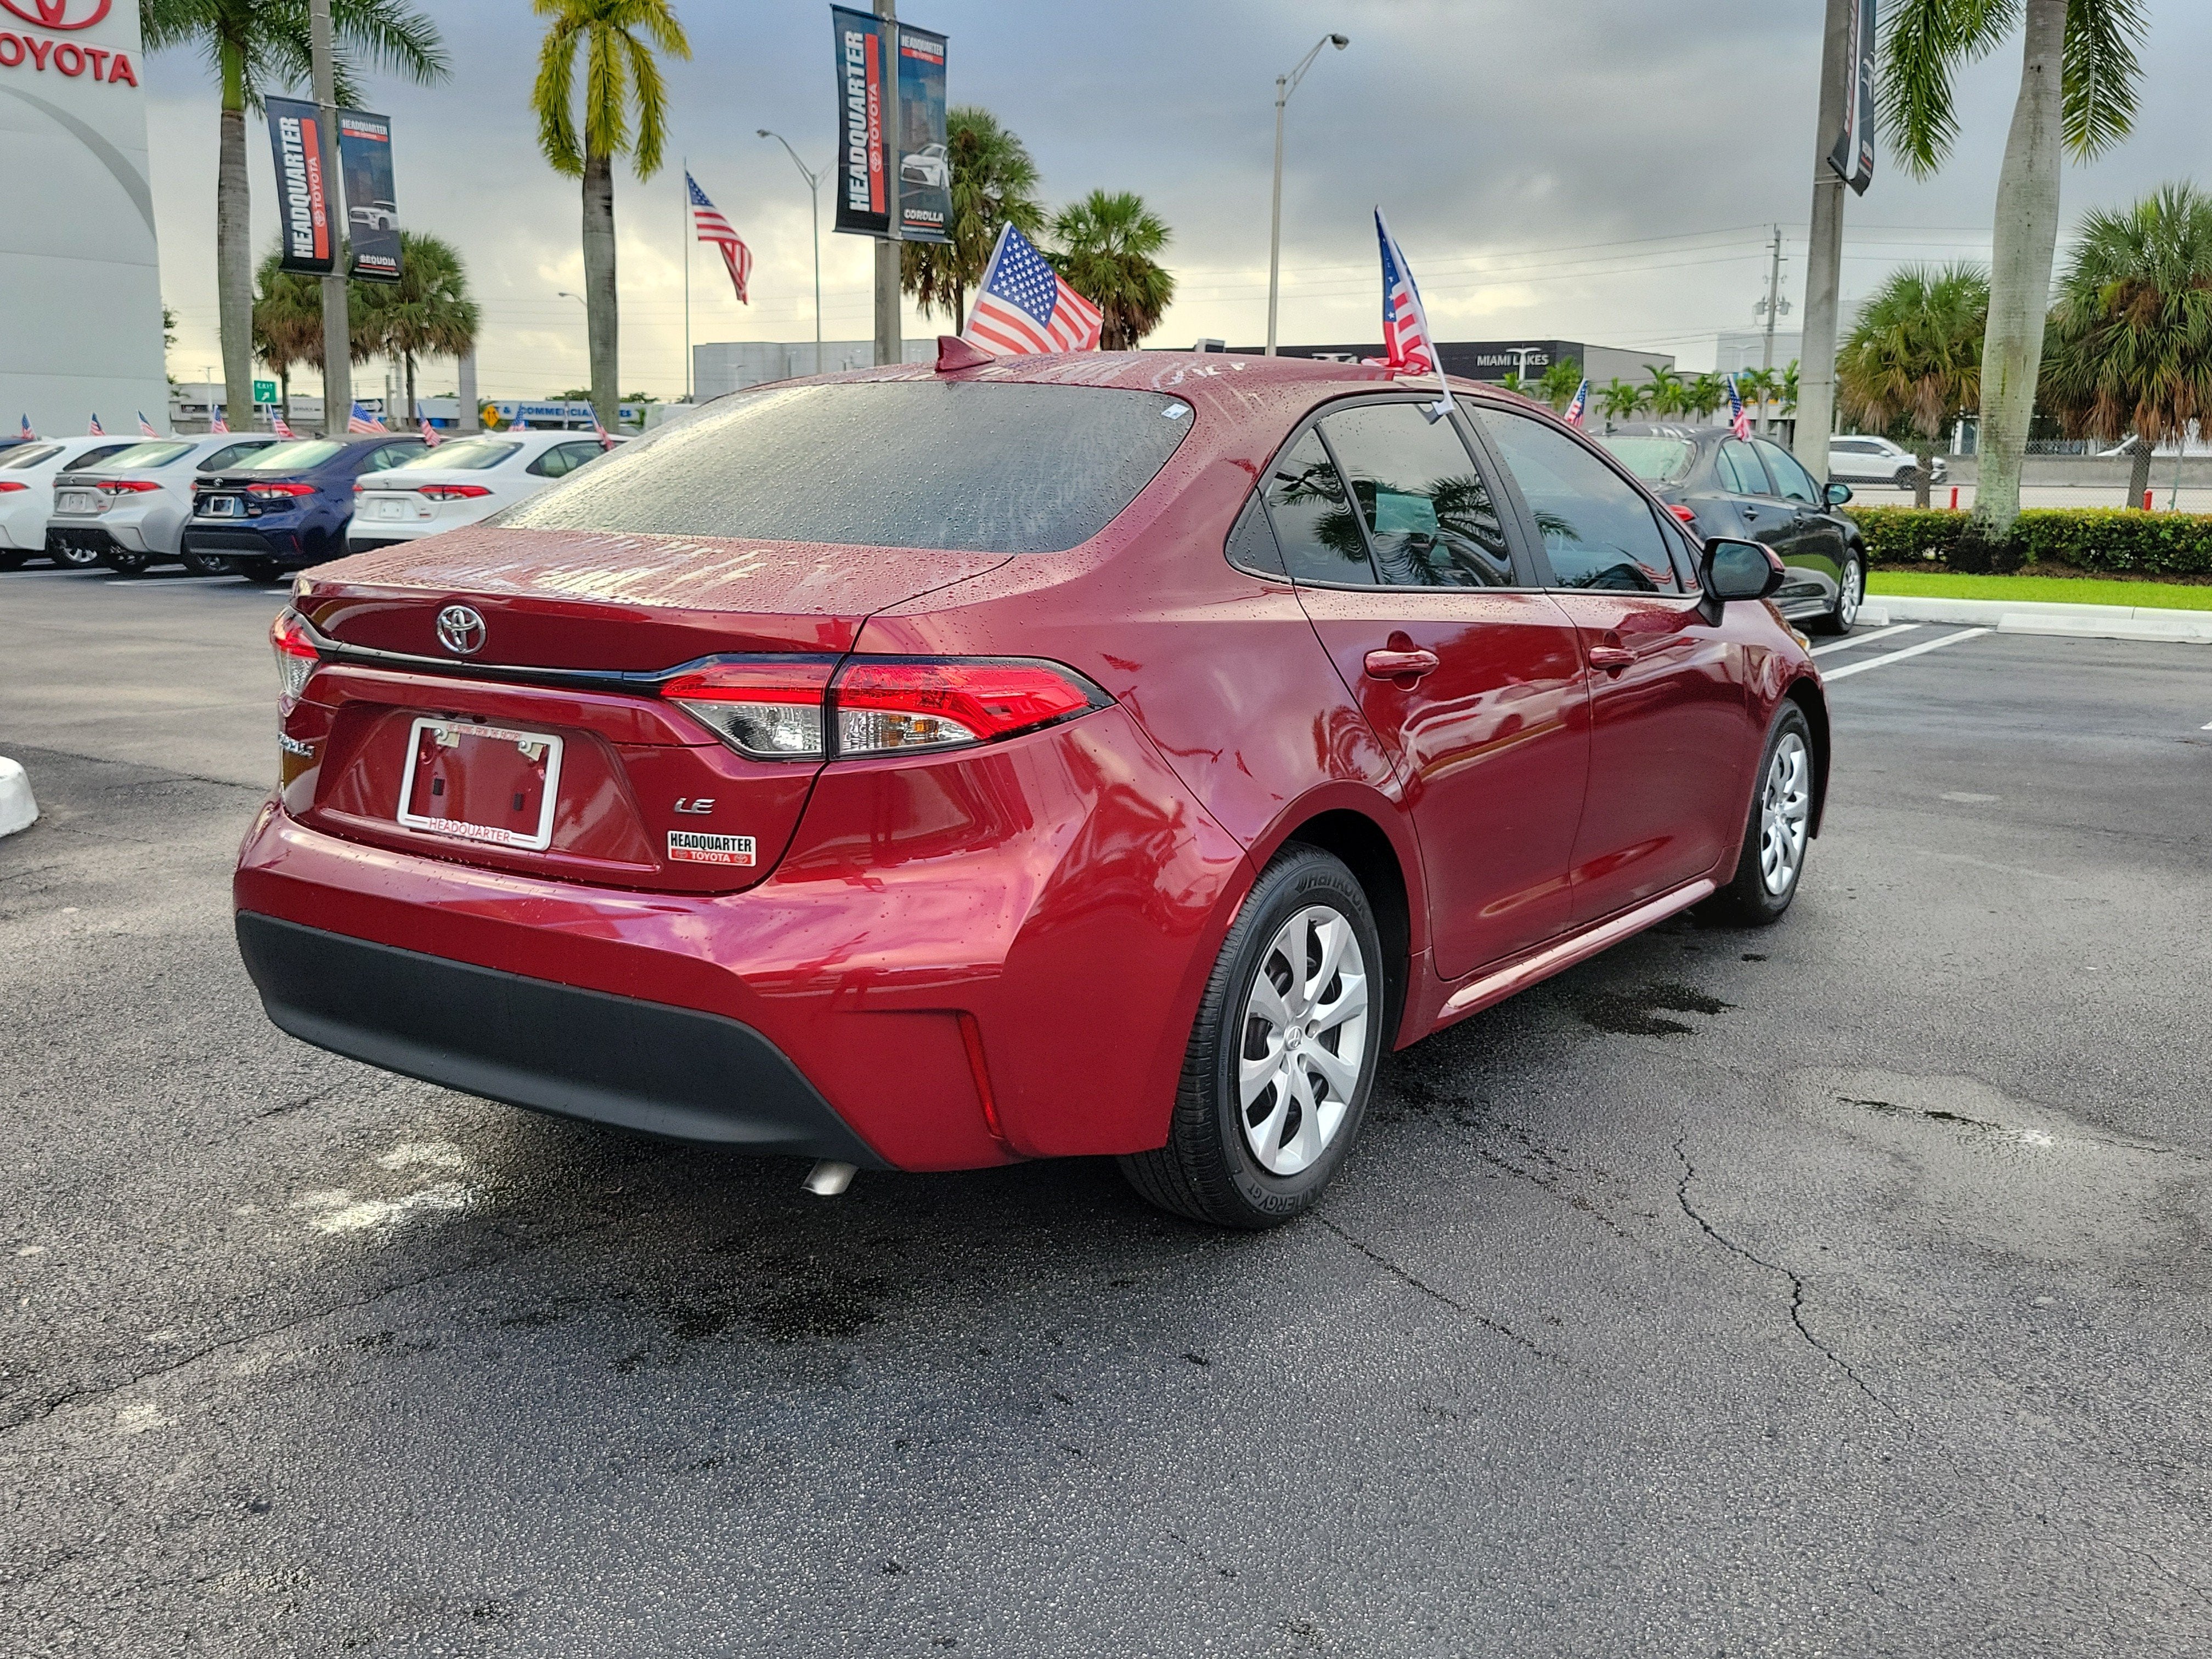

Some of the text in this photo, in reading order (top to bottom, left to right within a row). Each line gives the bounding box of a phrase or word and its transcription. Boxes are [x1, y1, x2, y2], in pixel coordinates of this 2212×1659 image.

[0, 33, 139, 87] OYOTA
[845, 31, 870, 212] HEADQUARTER
[868, 83, 879, 150] TOYOTA
[279, 117, 313, 258] HEADQUARTER
[308, 157, 323, 208] TOYOTA
[904, 209, 944, 223] COROLLA
[359, 254, 396, 266] SEQUOIA
[1477, 354, 1549, 366] MIAMI LKES
[674, 798, 715, 814] LE
[670, 833, 752, 852] HEADQUARTER
[691, 851, 731, 862] TOYOTA
